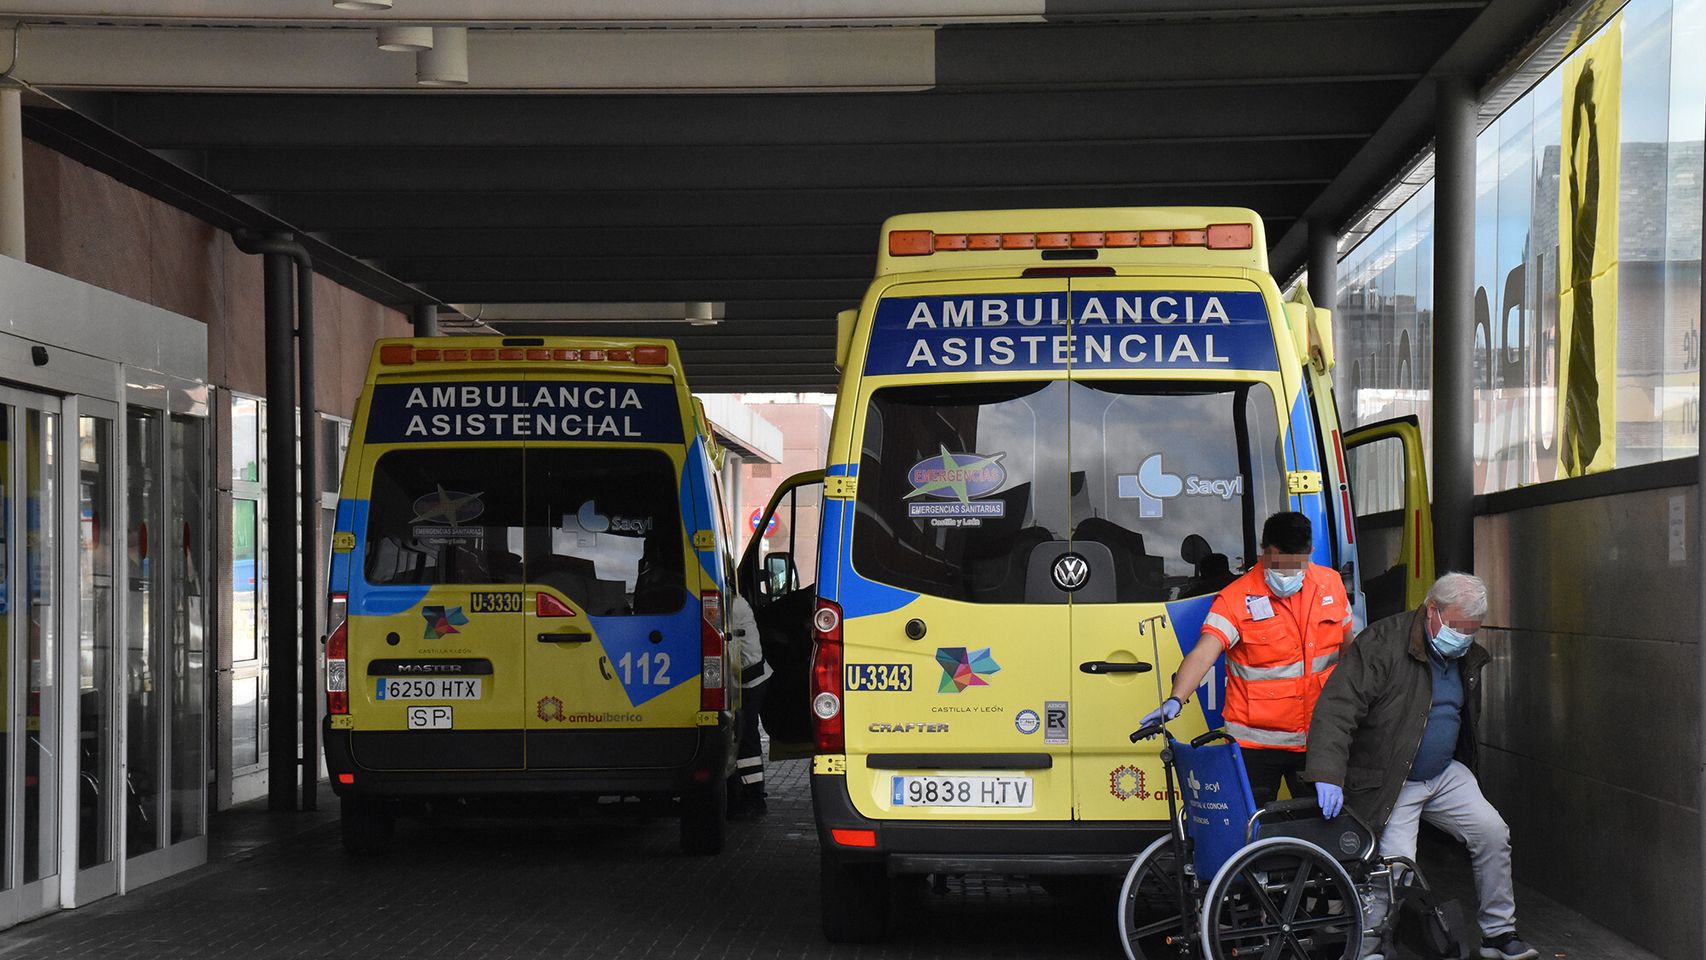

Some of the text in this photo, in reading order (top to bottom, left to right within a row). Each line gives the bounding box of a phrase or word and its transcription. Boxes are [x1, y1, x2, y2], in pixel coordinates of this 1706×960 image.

[906, 296, 1231, 330] AMBULANCIA
[906, 333, 1230, 368] ASISTENCIAL
[405, 386, 643, 409] AMBULANCIA
[404, 413, 642, 437] ASISTENCIAL
[914, 467, 999, 483] EMERGENCIAS
[1185, 475, 1243, 500] Sacyl
[911, 504, 1001, 514] EMERGENCIAS SANITARIAS
[611, 516, 654, 535] Sacyl
[472, 593, 520, 612] U-3330
[398, 664, 462, 673] MASTER
[618, 651, 671, 685] 112
[847, 665, 911, 691] U-3343
[390, 681, 435, 698] 6250
[442, 681, 476, 698] HTX
[980, 704, 1004, 713] LEÓN
[867, 722, 949, 733] CRAFTER
[909, 780, 971, 803] 9838
[980, 781, 1027, 804] HTV
